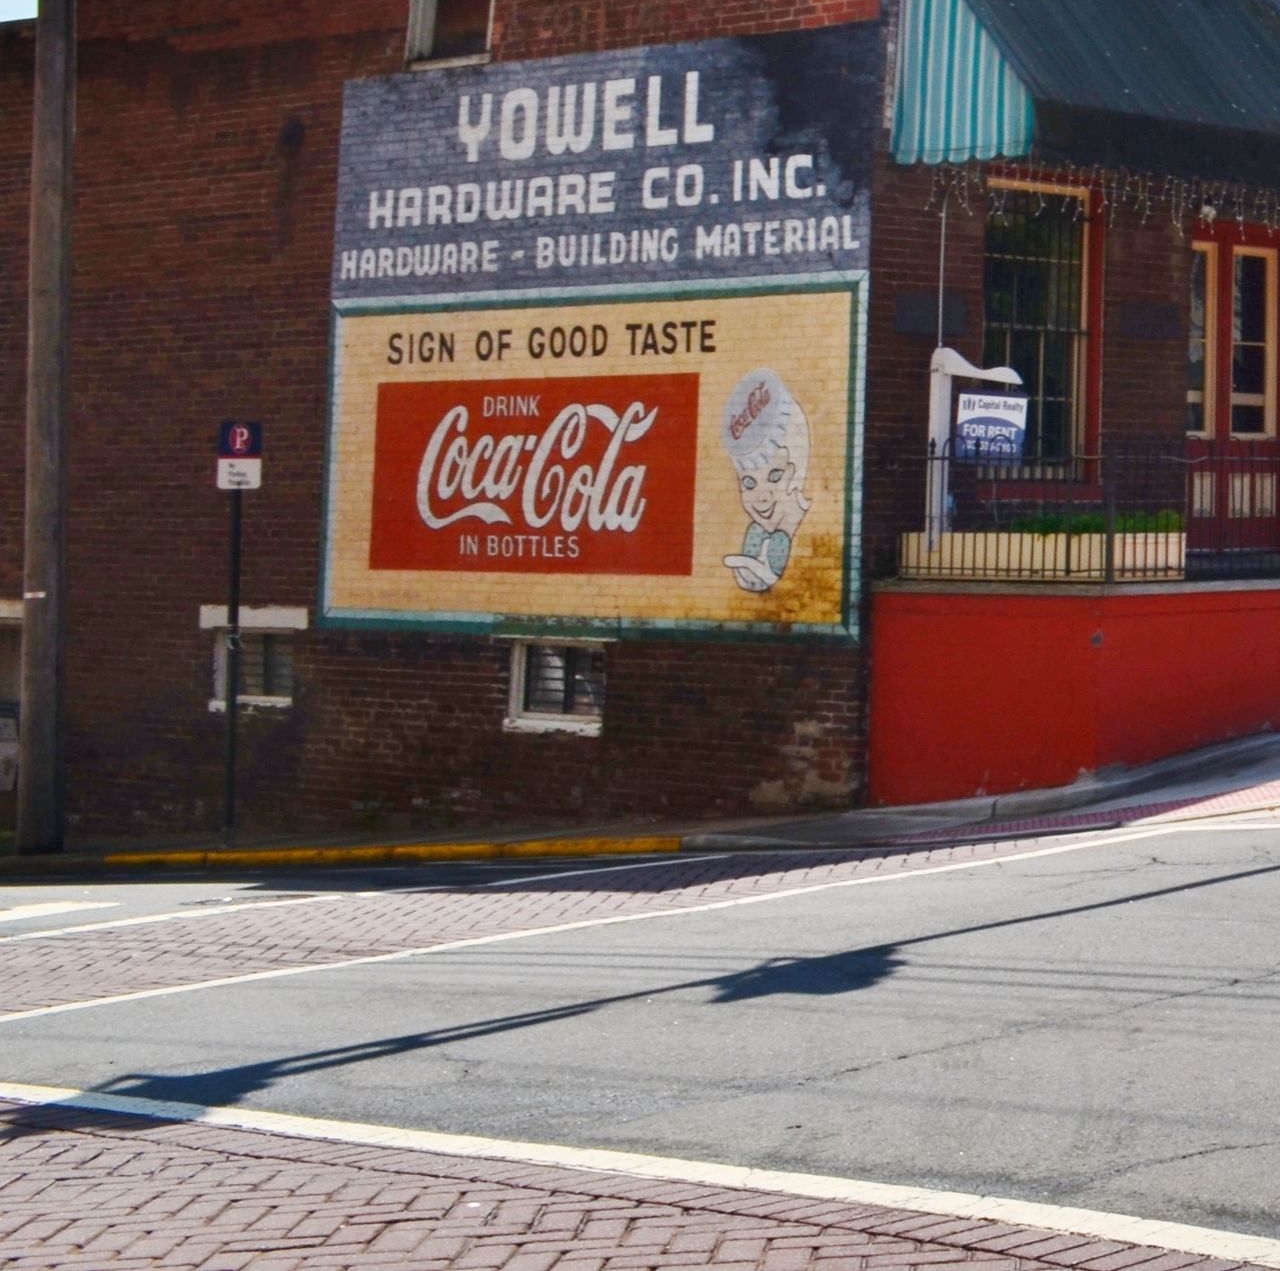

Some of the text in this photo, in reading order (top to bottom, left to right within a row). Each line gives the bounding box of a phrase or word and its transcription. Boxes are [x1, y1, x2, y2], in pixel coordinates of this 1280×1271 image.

[458, 70, 714, 163] YOWELL
[369, 154, 826, 228] HARDWARE CO. INC.
[341, 241, 499, 280] HARDWARE
[536, 227, 679, 269] BUILDING
[696, 215, 861, 257] MATERIAL
[387, 320, 717, 365] SIGN OF GOOD TASTE
[483, 395, 541, 418] DRINK
[730, 379, 770, 440] Coca-Cola
[963, 423, 1019, 440] FOR RENT
[235, 427, 248, 449] P
[416, 401, 659, 532] Coca-Cola
[459, 535, 580, 558] IN BOTTLES
